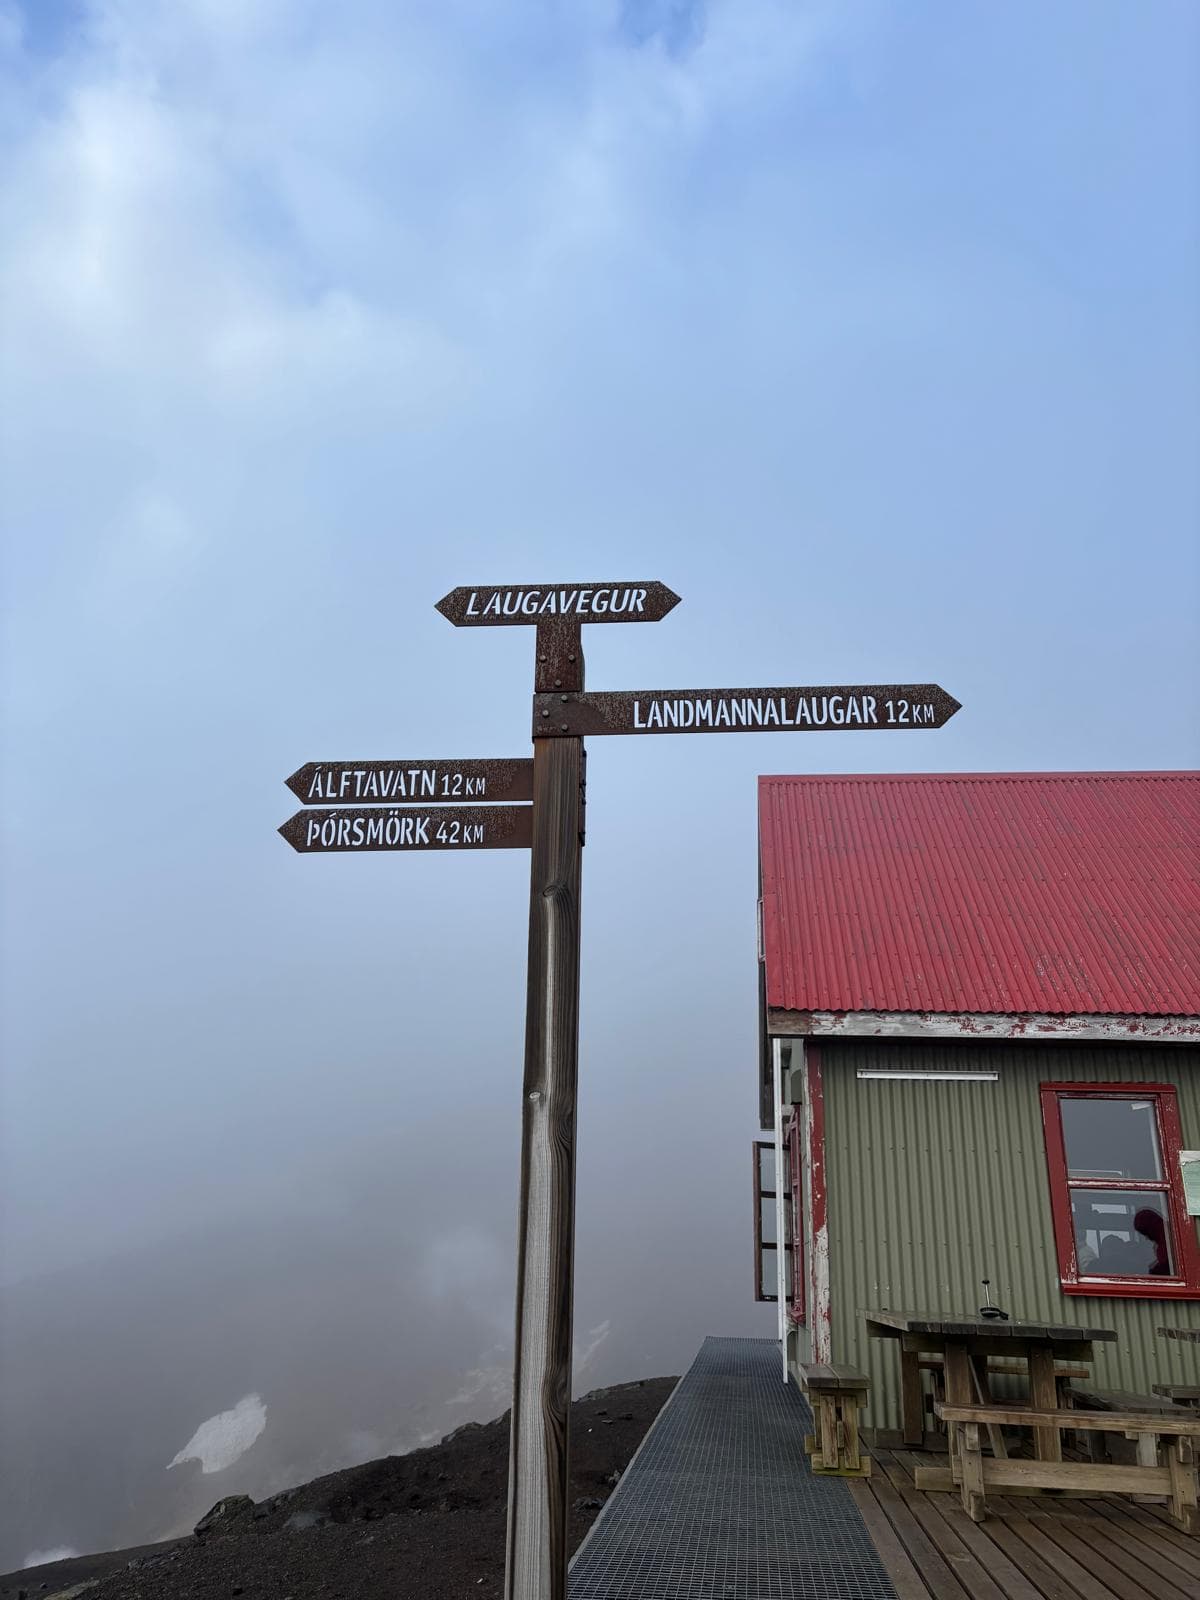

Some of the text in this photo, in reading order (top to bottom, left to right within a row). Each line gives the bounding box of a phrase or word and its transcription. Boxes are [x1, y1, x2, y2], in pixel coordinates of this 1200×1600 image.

[465, 588, 648, 616] LAUGAVEGUR
[633, 695, 878, 729] LANDMANNALAUGAR
[307, 765, 436, 798] ÁLFTAVATN
[306, 810, 430, 847] ÞÓRSMÖRK
